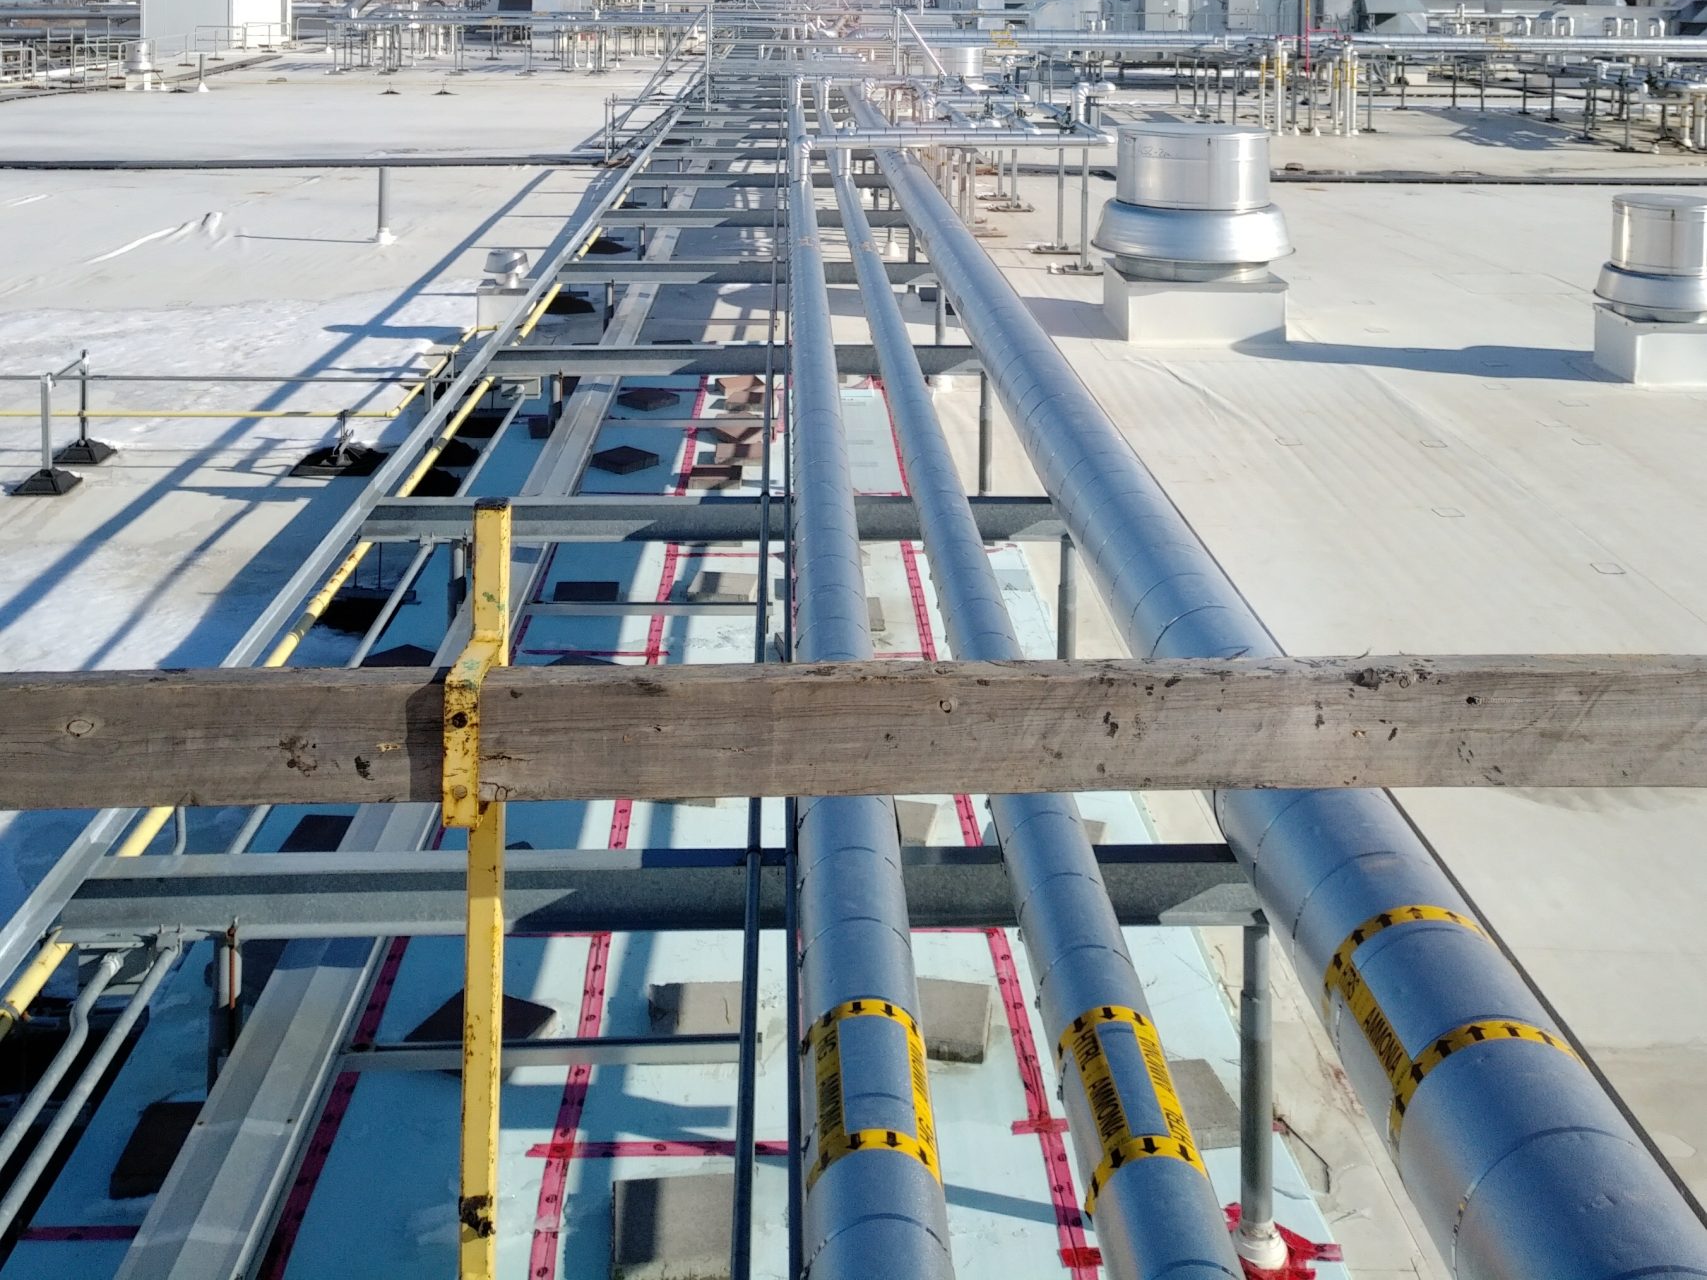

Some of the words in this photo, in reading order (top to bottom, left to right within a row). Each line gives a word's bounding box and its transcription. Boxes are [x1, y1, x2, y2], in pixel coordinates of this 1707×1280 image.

[1073, 1029, 1102, 1072] HTRL
[1089, 1076, 1126, 1142] AMMONIA
[1364, 1006, 1403, 1078] AMMONIA
